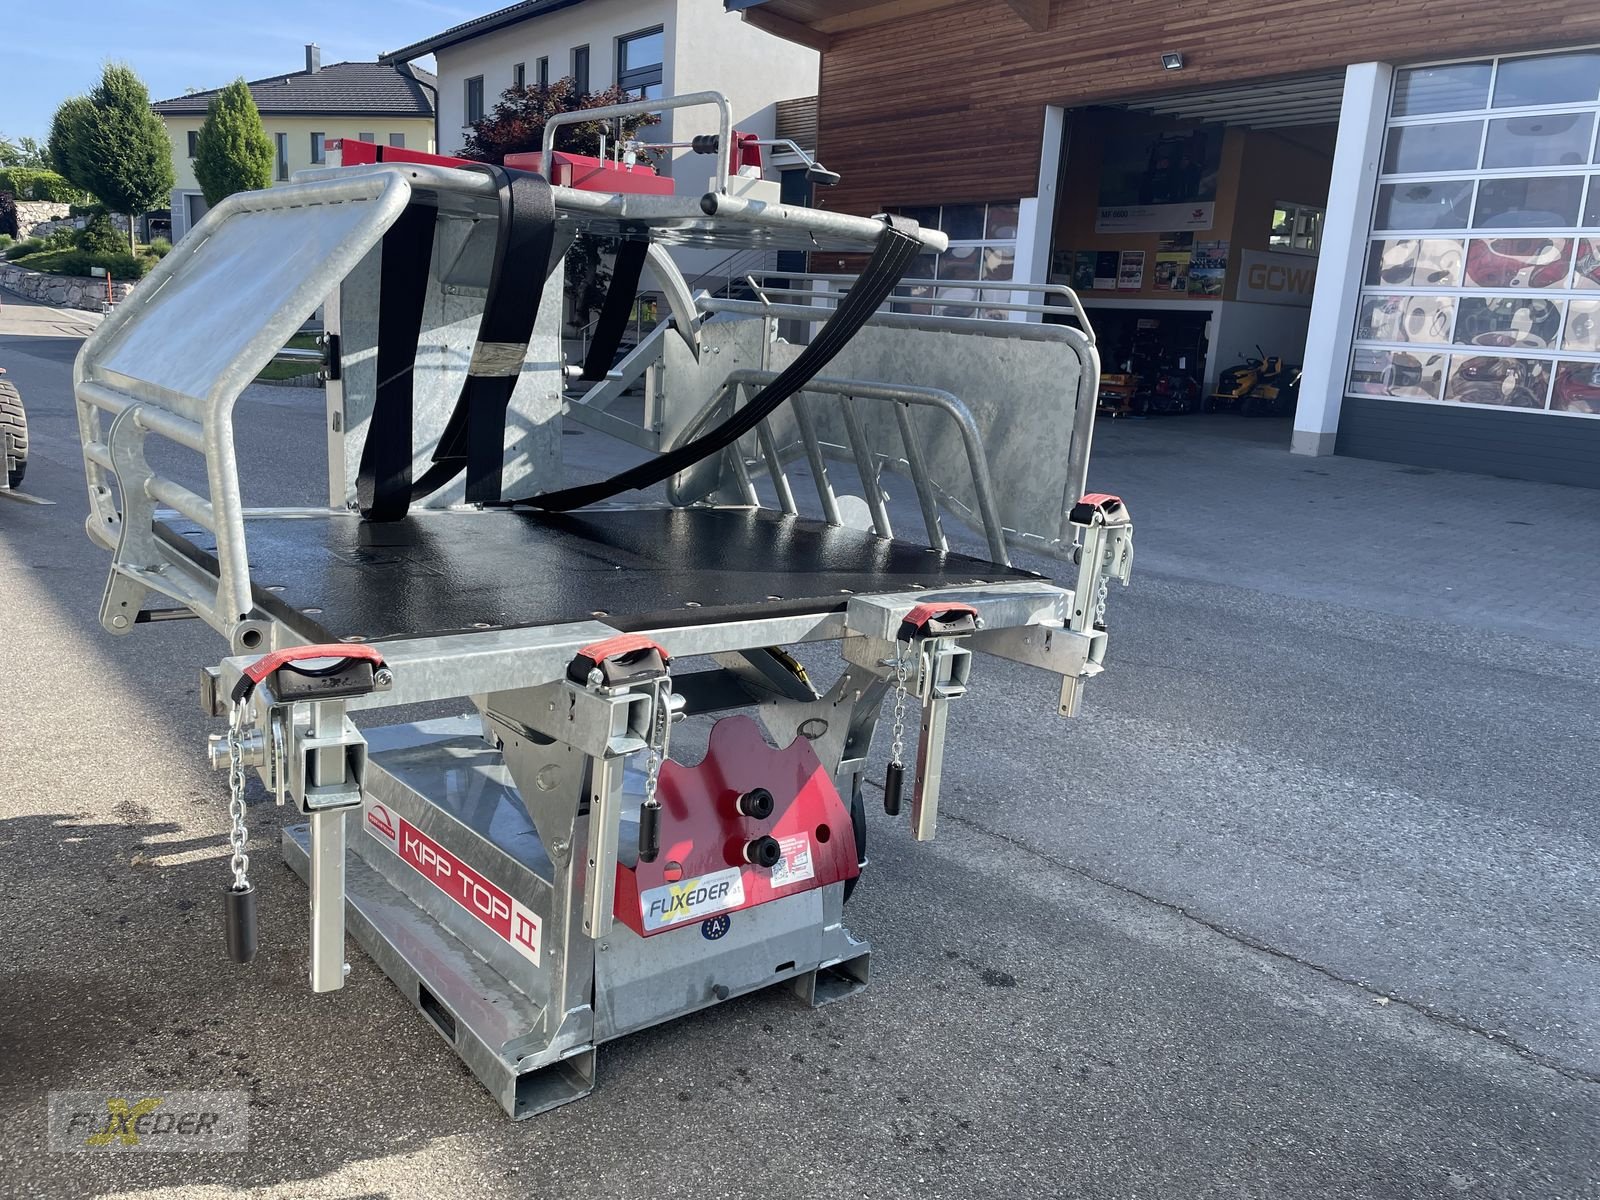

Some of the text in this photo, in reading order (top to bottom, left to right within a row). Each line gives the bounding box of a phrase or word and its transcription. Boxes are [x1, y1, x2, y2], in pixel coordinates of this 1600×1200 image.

[1101, 210, 1112, 218] MF
[405, 832, 537, 953] KIPP TOP II
[649, 881, 730, 918] FLIXEDER
[712, 921, 721, 932] A
